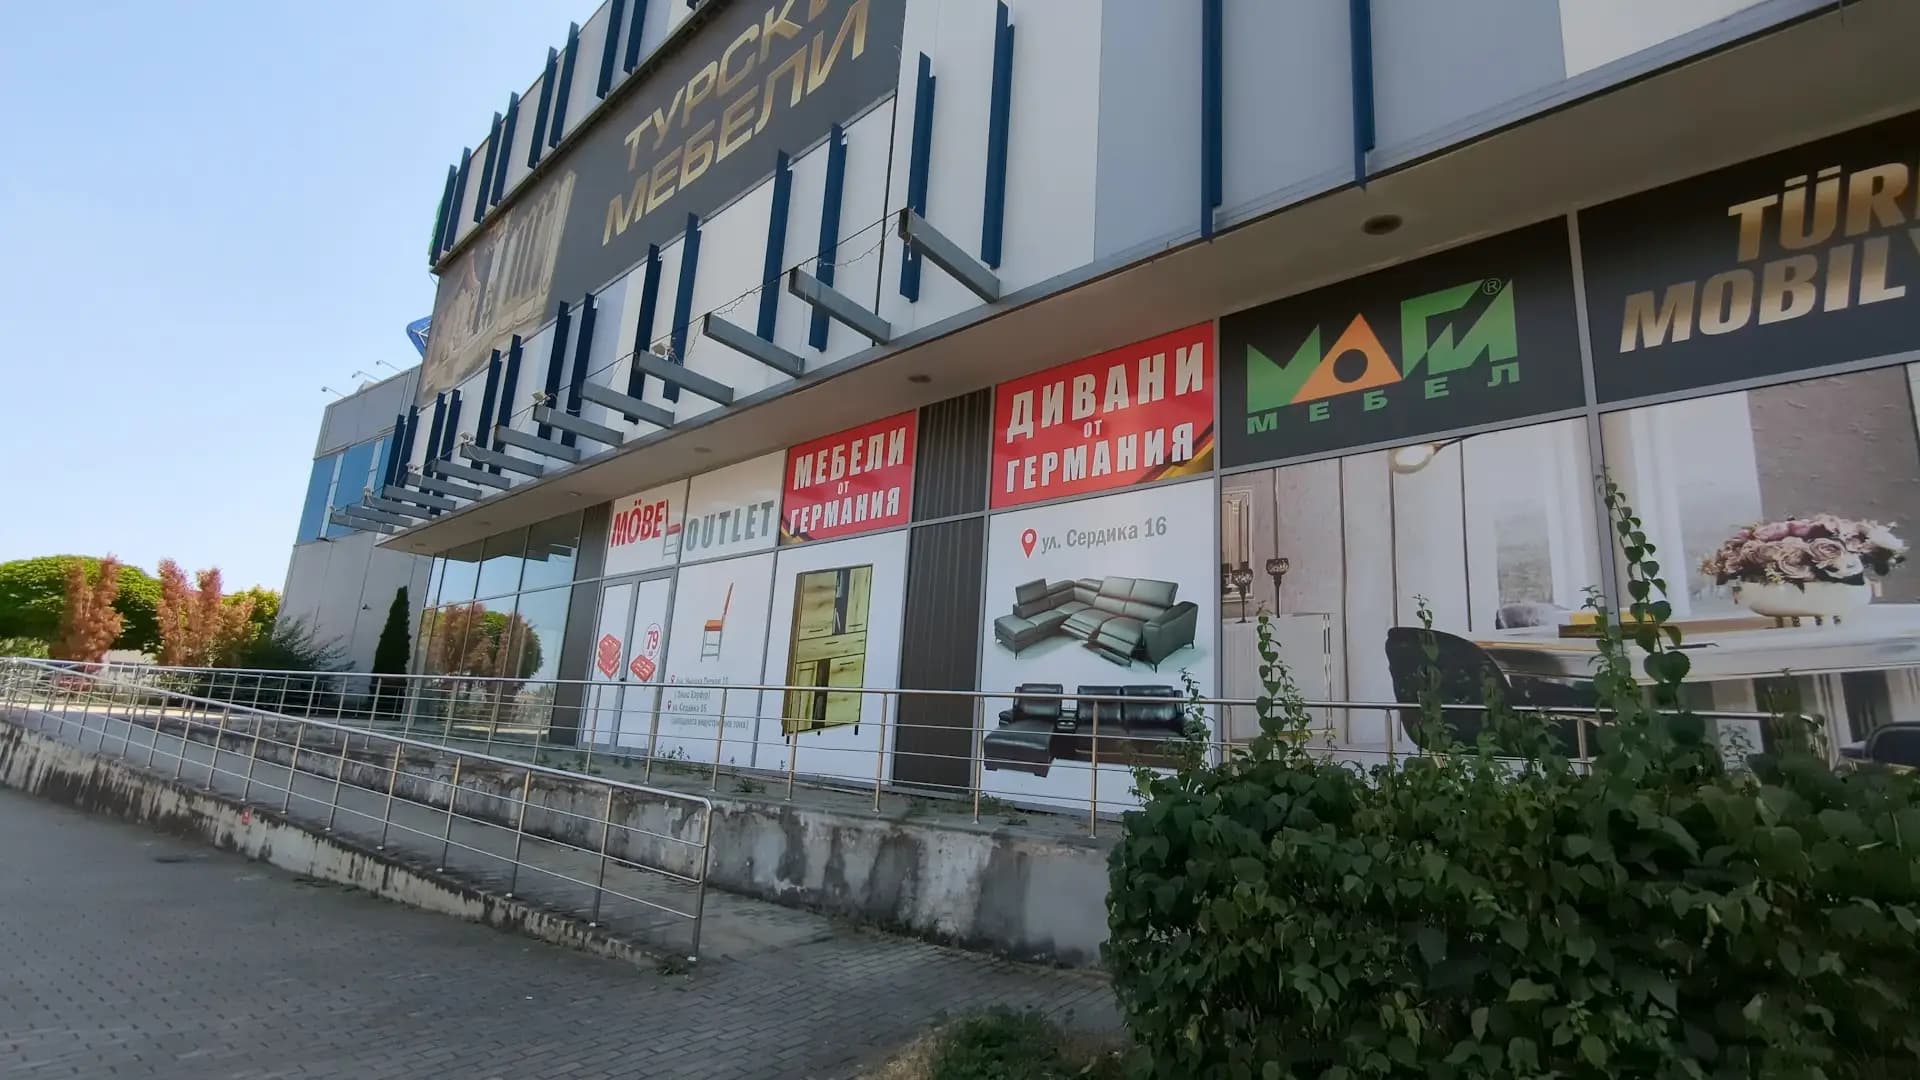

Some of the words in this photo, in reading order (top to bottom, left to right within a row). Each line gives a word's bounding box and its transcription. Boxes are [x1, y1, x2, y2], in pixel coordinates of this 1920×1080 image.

[602, 0, 869, 247] МЕБЕЛИ
[624, 0, 830, 173] ТУРСК
[1728, 161, 1920, 263] TÜR
[1619, 228, 1920, 353] MOBIL
[1006, 342, 1204, 444] ДИВАНИ
[793, 427, 906, 491] МЕБЕЛИ
[1006, 422, 1193, 493] ГЕРМАНИЯ
[685, 500, 775, 551] OUTLET
[789, 486, 901, 536] ГЕРМАНИЯ
[1041, 536, 1061, 555] ул.
[1066, 524, 1138, 549] Сердика
[1144, 516, 1168, 538] 16
